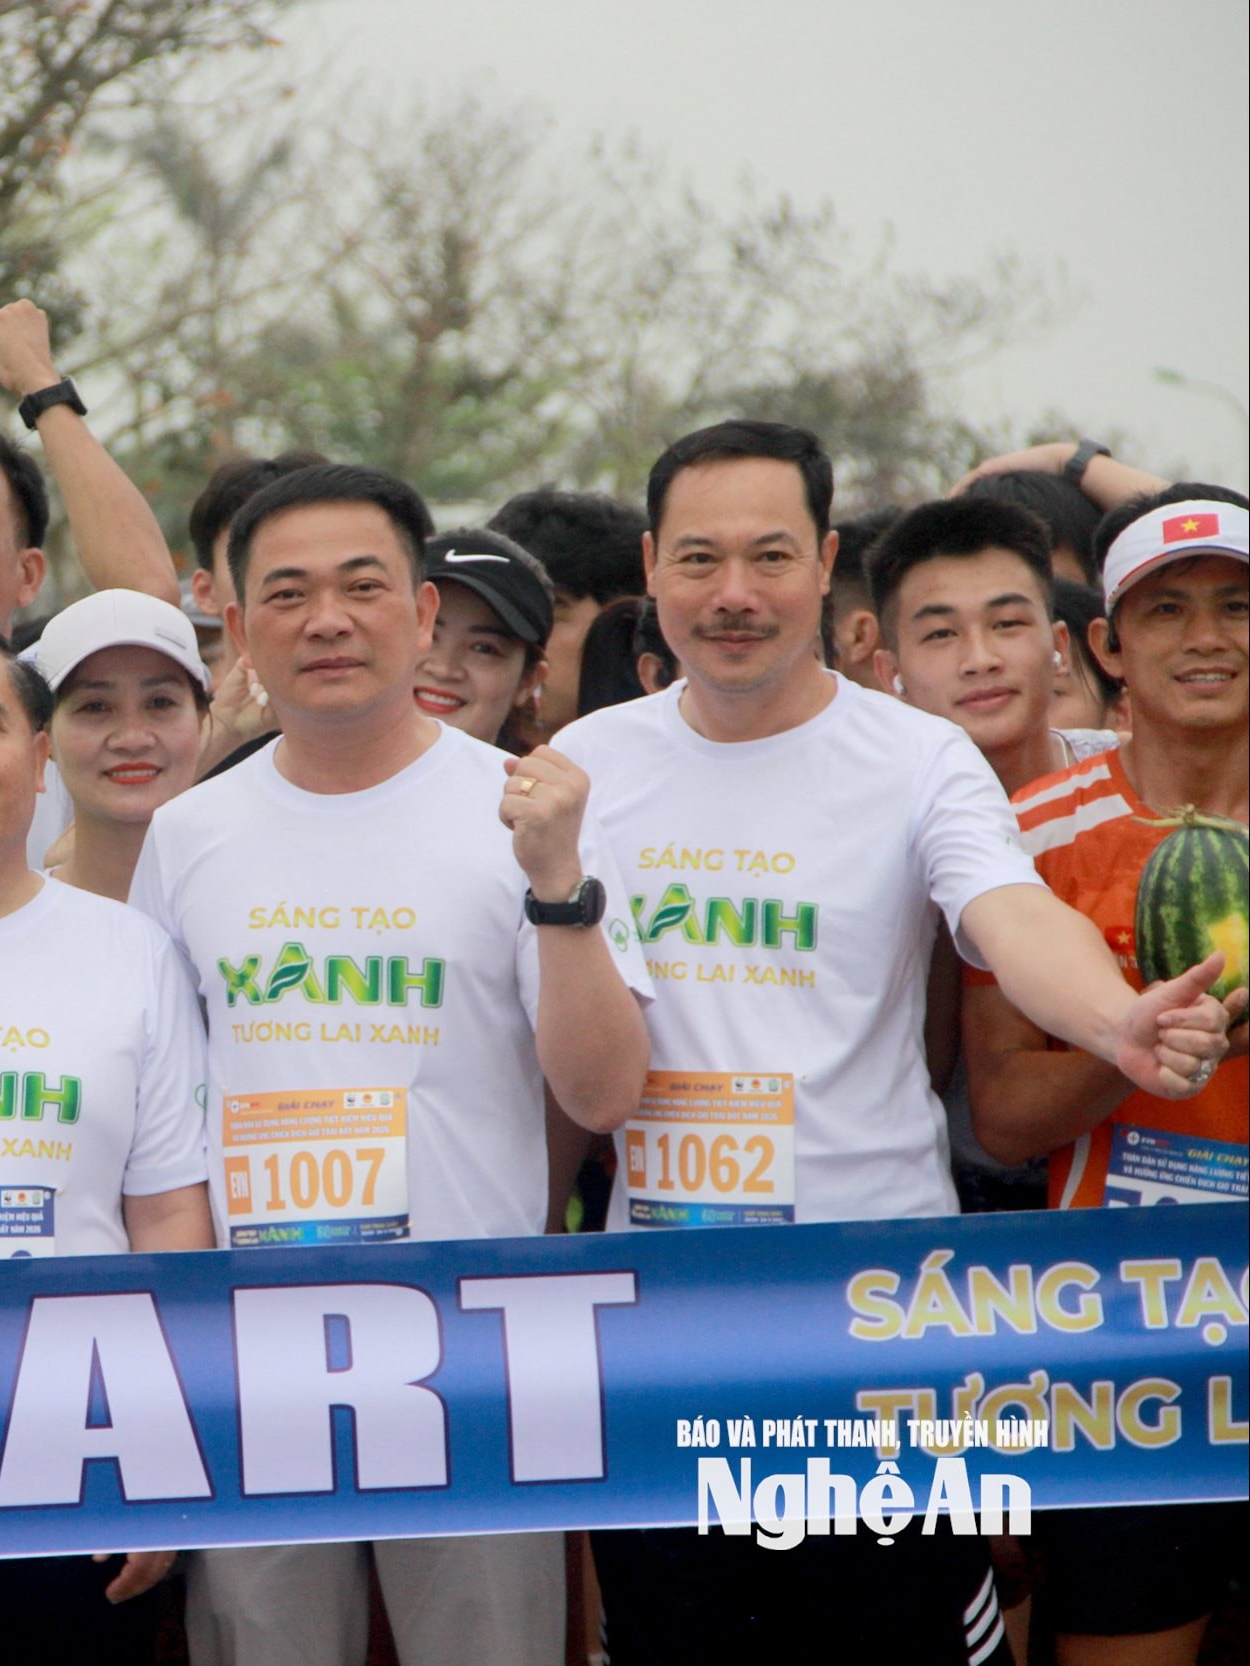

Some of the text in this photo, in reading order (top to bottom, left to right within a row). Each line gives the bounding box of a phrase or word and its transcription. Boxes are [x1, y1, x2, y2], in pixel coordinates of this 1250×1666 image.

[638, 841, 796, 878] SÁNG TẠO
[248, 901, 416, 935] SÁNG TẠO
[696, 963, 735, 982] LAI
[743, 965, 815, 988] XANH
[232, 1020, 440, 1047] TƯƠNG LAI XANH
[1, 1137, 73, 1162] XANH
[657, 1132, 776, 1193] 1062
[264, 1148, 385, 1211] 1007
[847, 1249, 1249, 1347] SÁNG TẠ
[857, 1369, 1182, 1460] TƯƠNG
